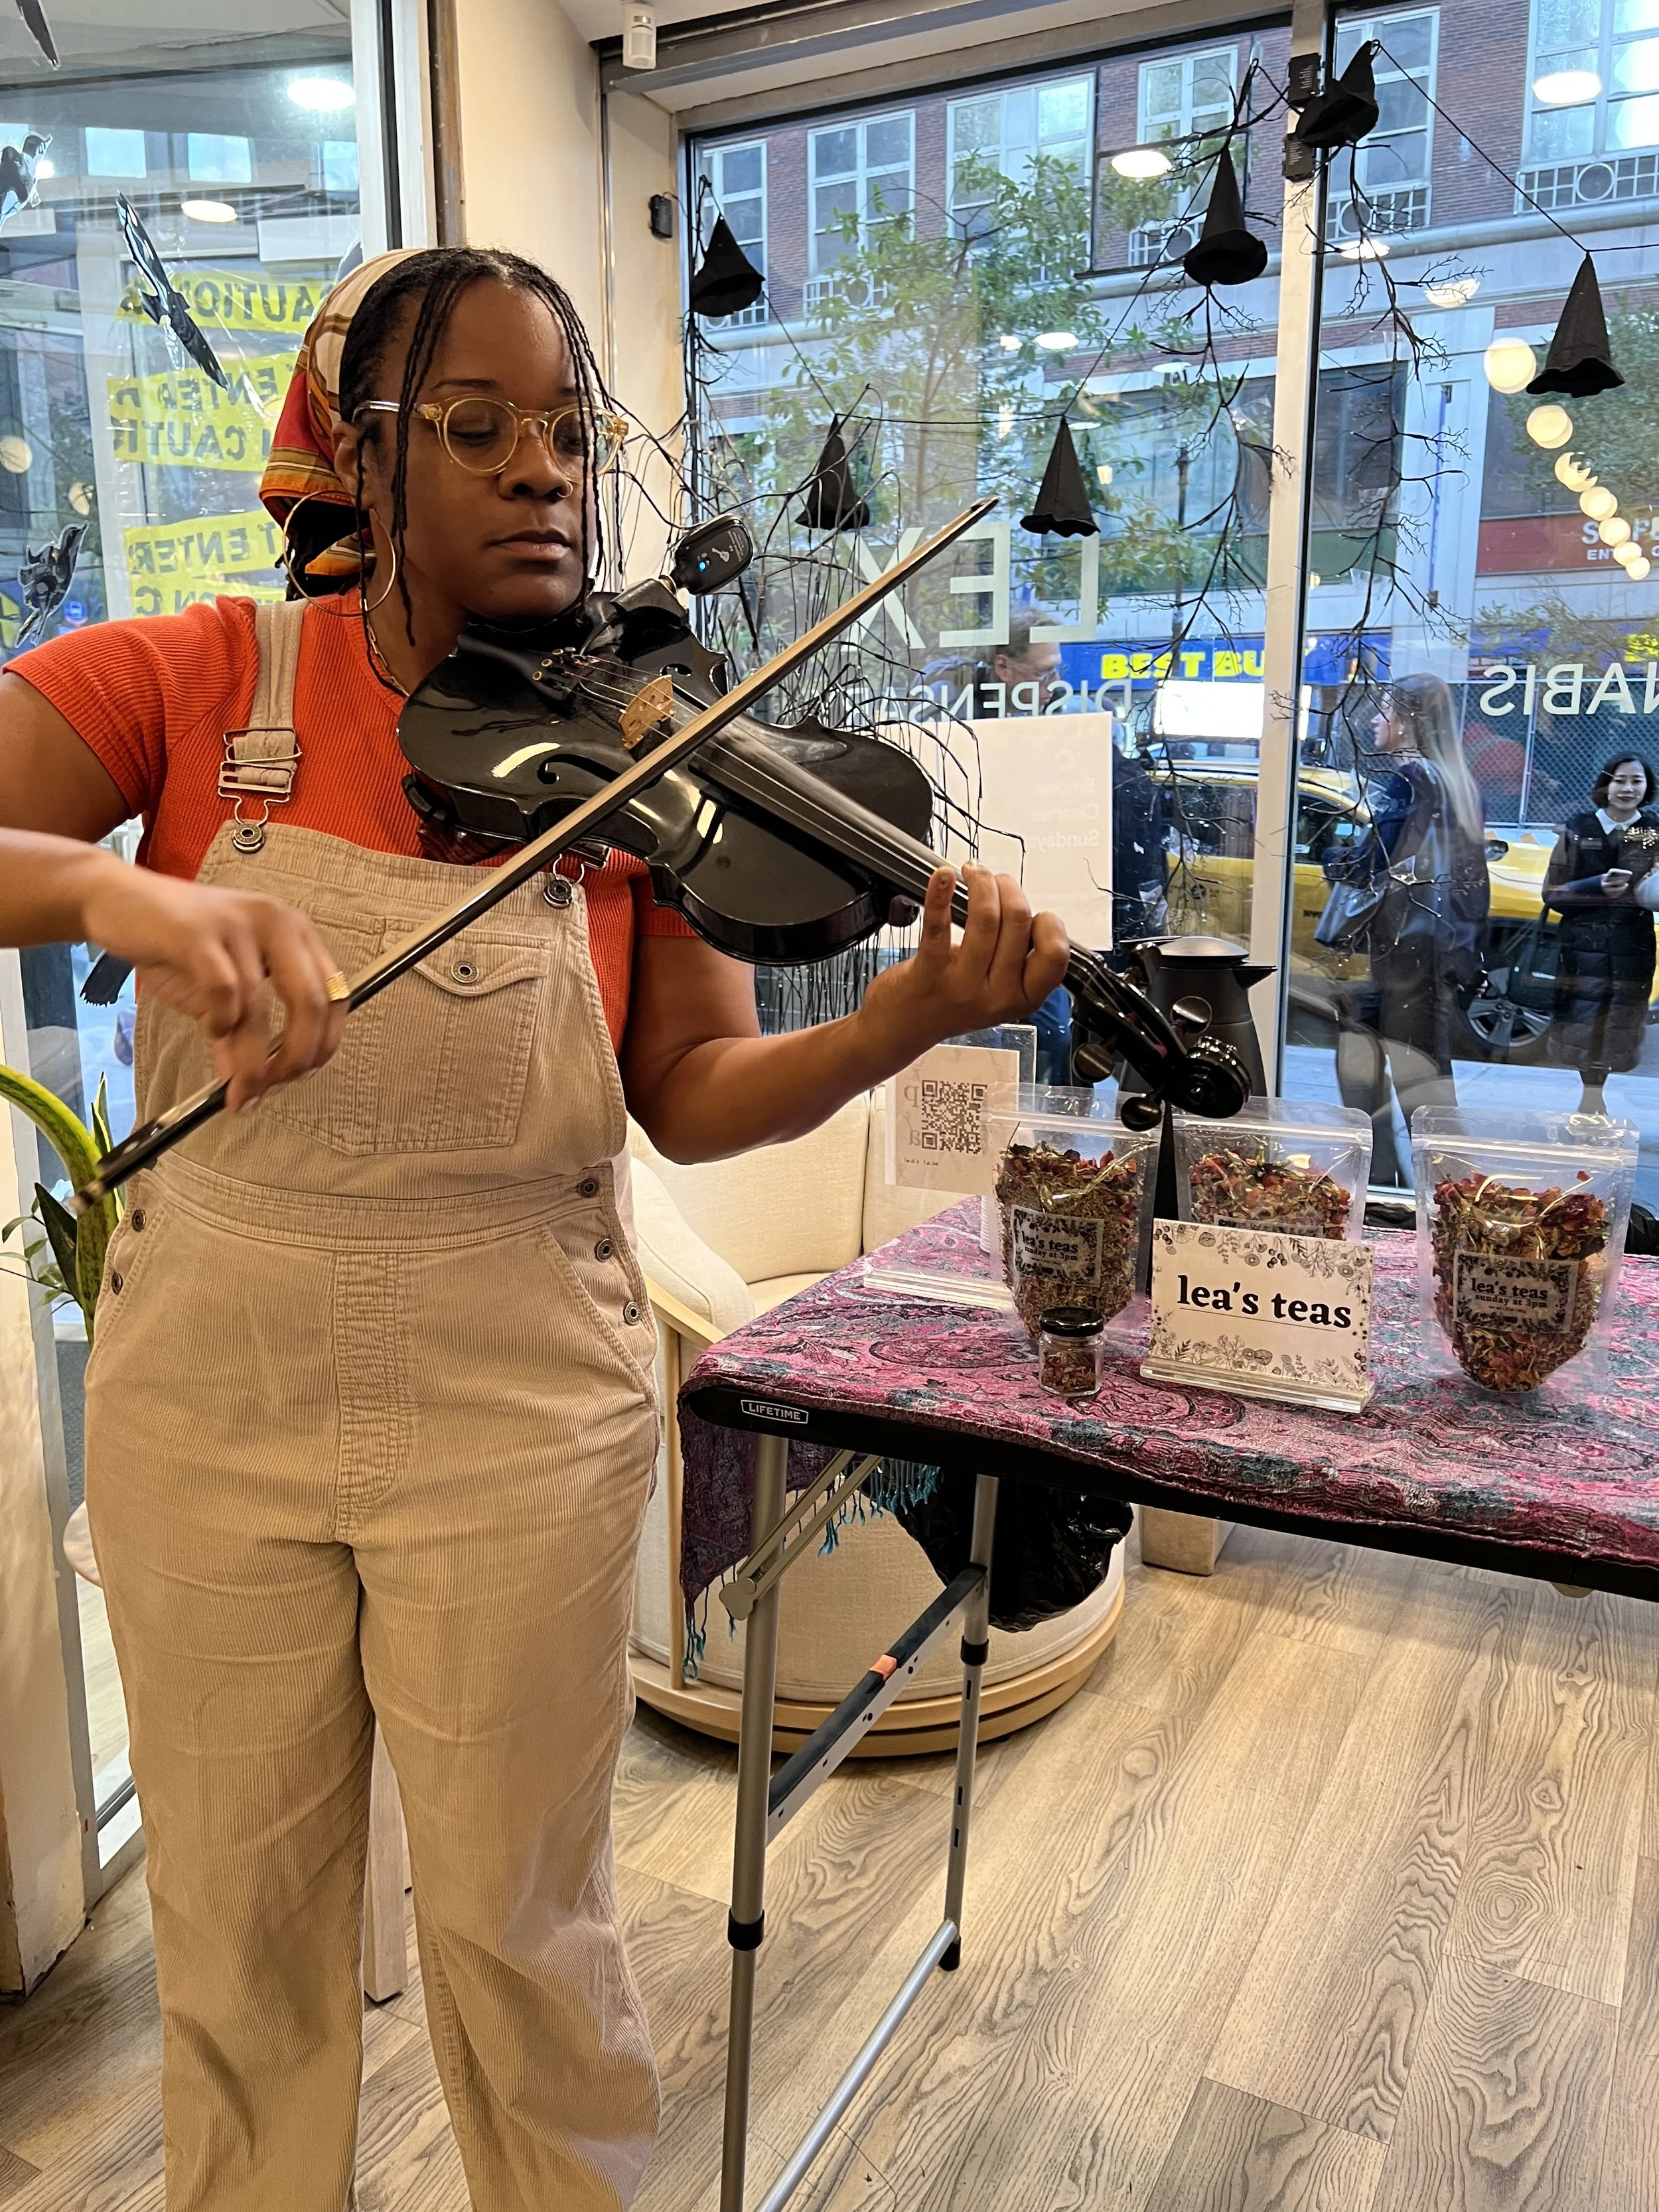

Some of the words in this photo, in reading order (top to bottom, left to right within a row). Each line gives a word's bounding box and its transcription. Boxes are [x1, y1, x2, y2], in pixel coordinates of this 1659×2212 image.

[1101, 652, 1205, 679] BEST
[1022, 1230, 1045, 1248] lea's
[1048, 1239, 1078, 1253] teas
[1471, 1278, 1507, 1295] lea's
[1512, 1285, 1548, 1300] teas
[1177, 1274, 1259, 1315] lea's
[1271, 1293, 1351, 1328] teas
[1475, 1295, 1510, 1305] sunday
[1526, 1300, 1548, 1309] 3pm
[749, 1403, 800, 1420] LIFETIME
